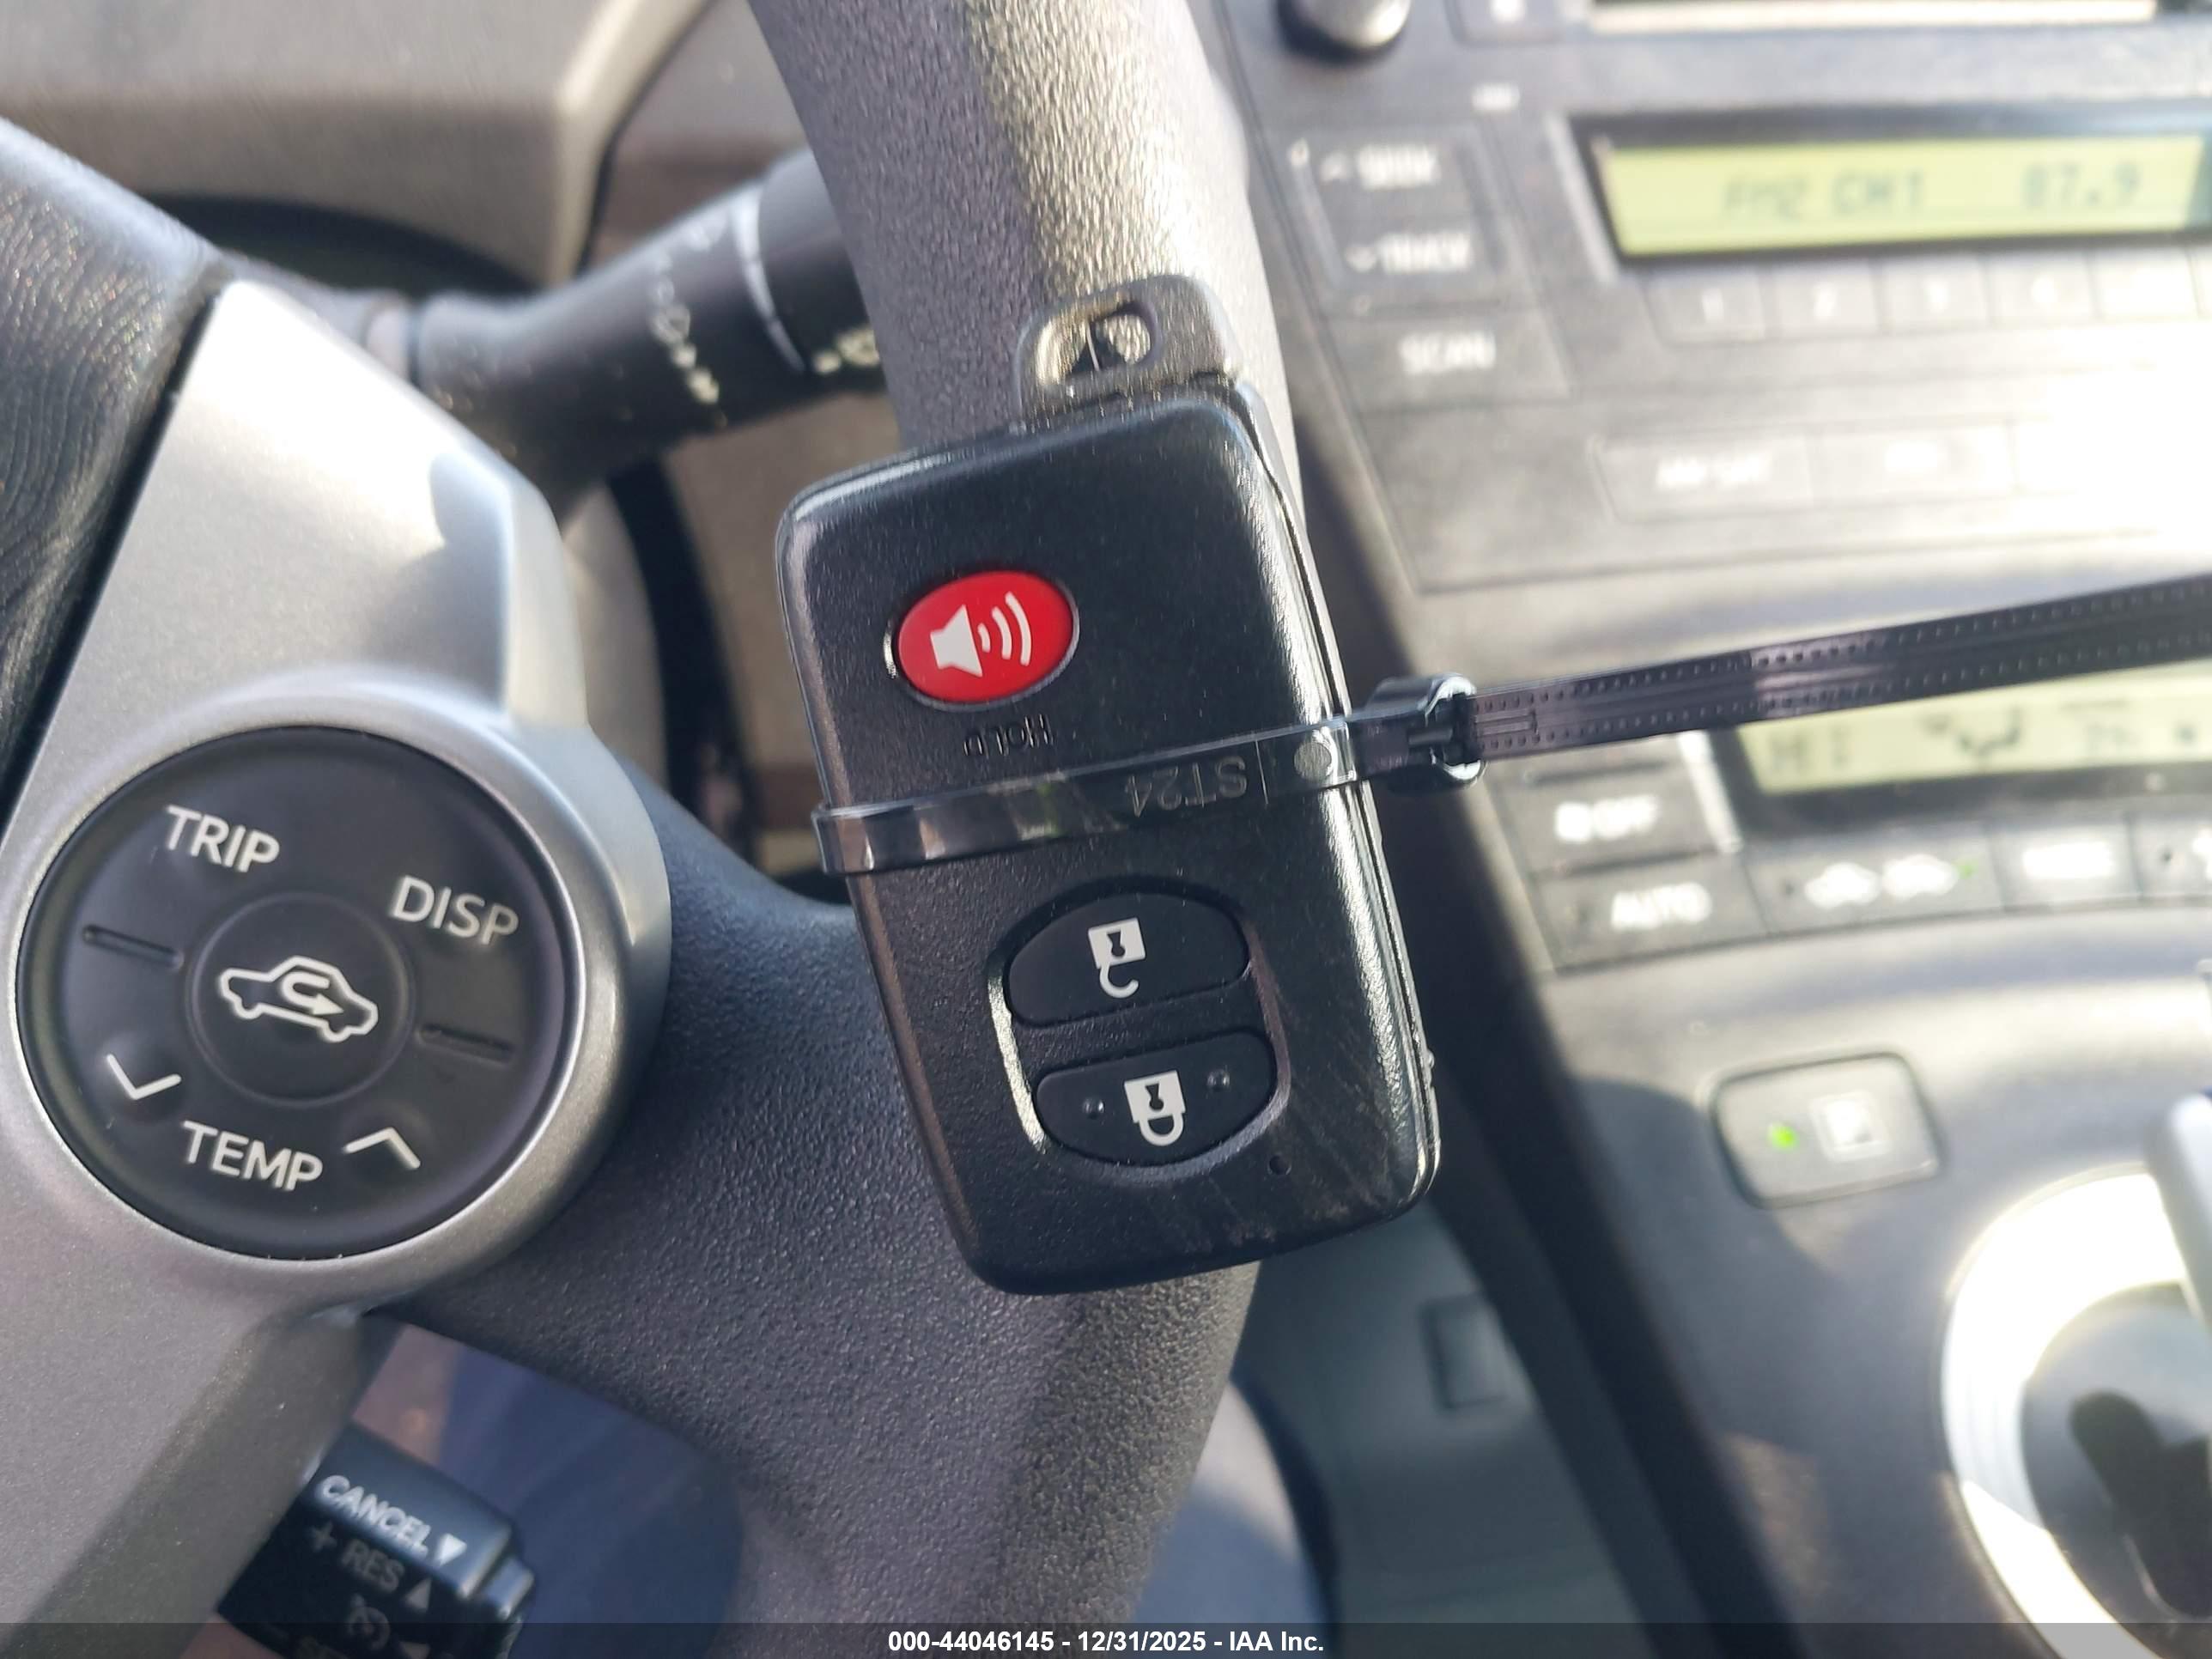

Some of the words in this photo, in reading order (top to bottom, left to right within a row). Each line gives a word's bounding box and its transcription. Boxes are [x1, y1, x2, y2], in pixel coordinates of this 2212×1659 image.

[1122, 755, 1249, 817] ST24
[167, 804, 281, 874] TRIP
[391, 875, 520, 946] DISP
[181, 1120, 324, 1192] TEMP
[314, 1474, 432, 1560] CANCEL
[341, 1539, 406, 1593] RES
